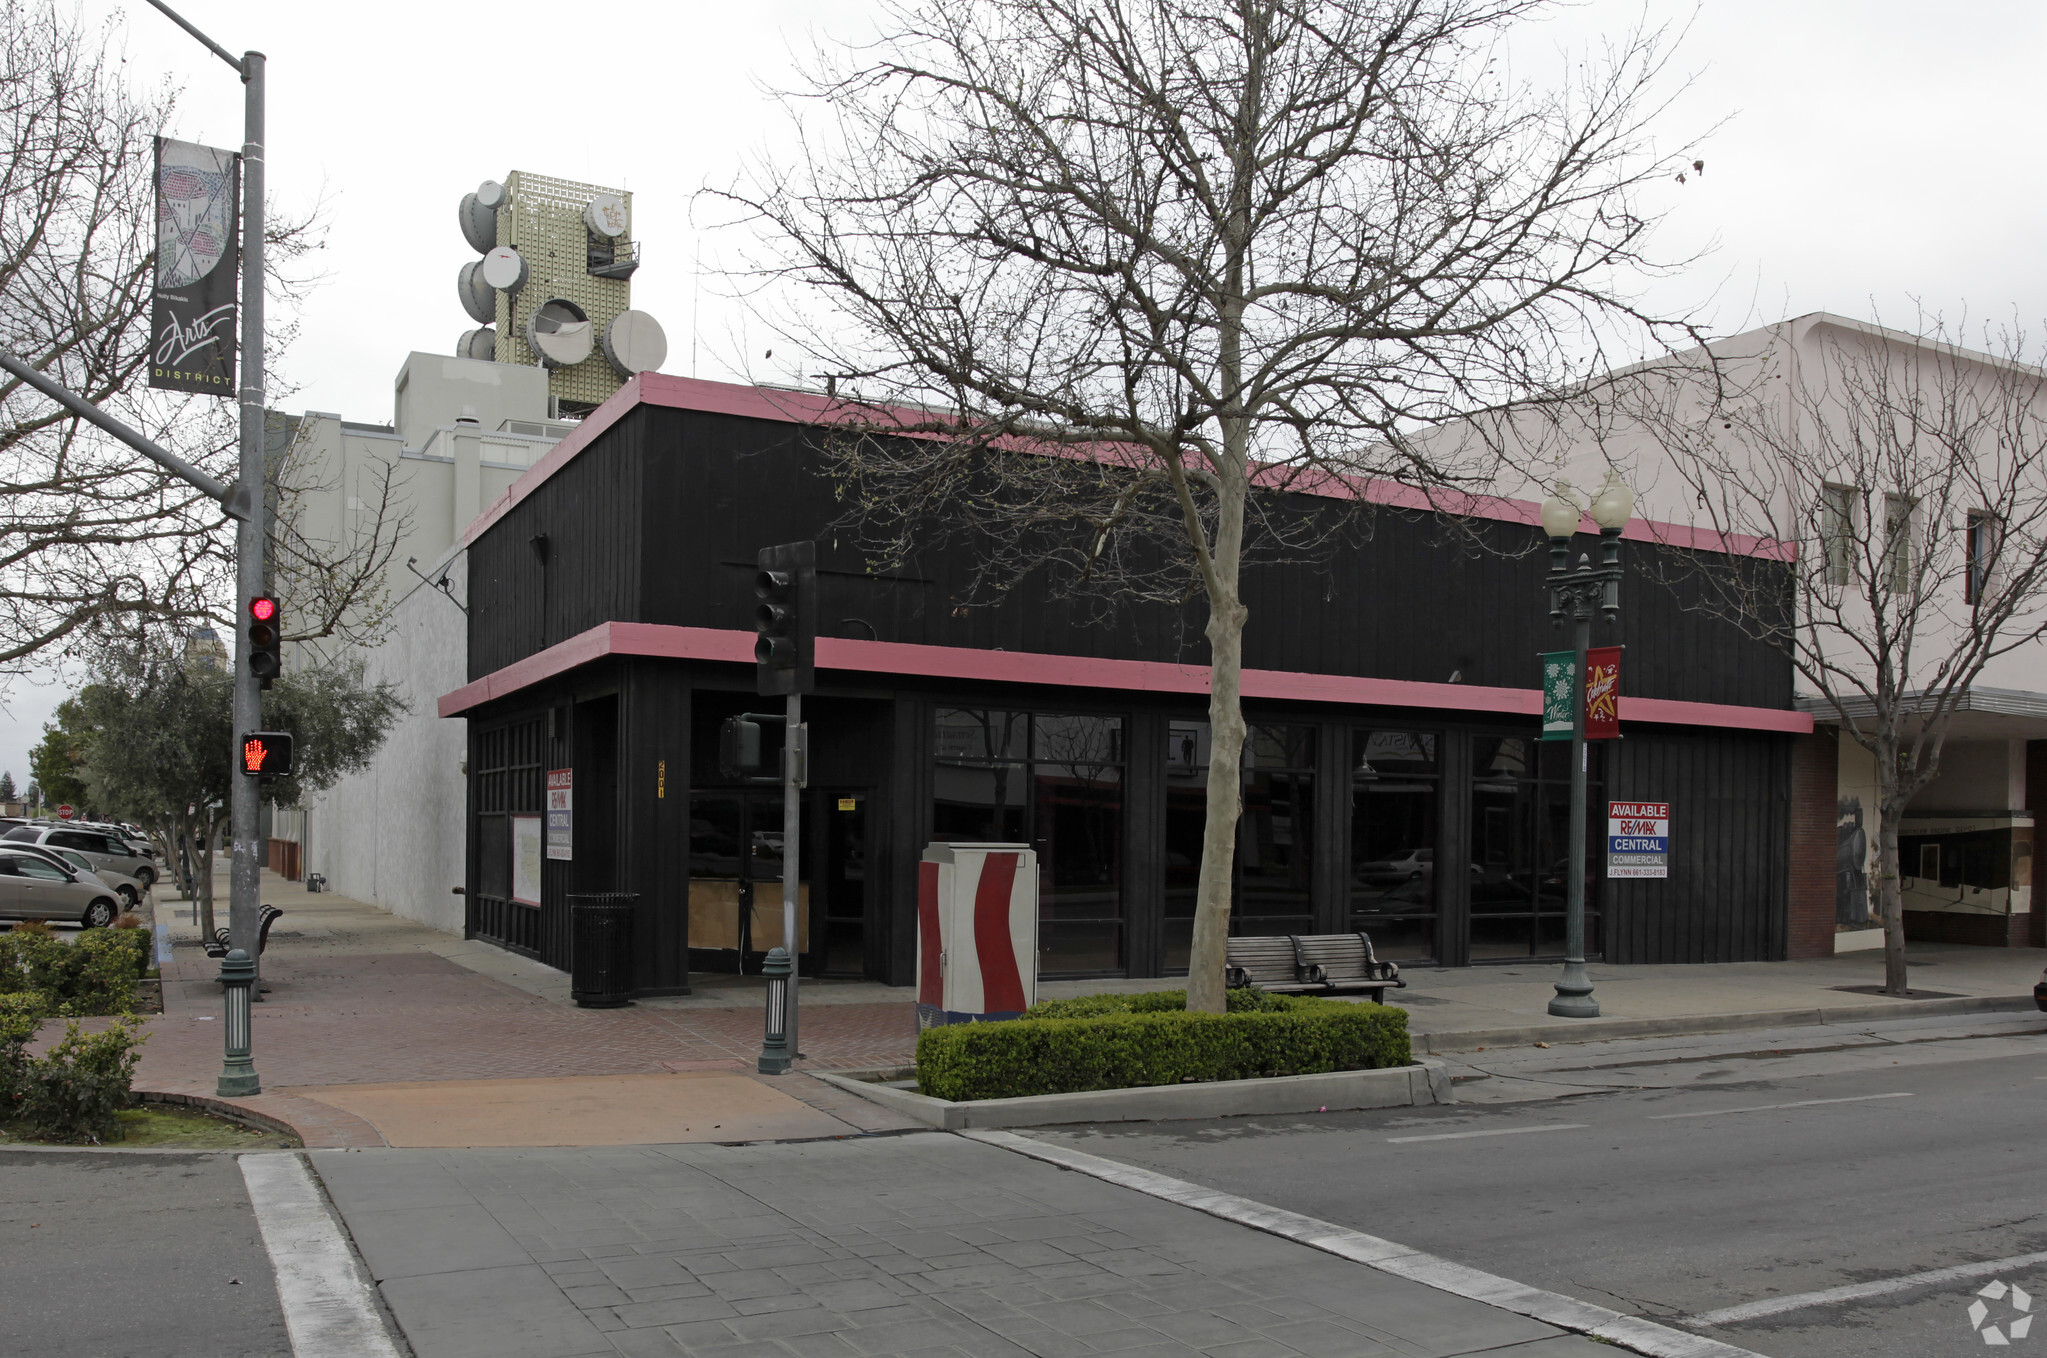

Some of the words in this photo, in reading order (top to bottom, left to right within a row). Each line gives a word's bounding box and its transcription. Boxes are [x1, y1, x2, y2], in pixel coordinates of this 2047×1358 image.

[156, 303, 235, 366] Arts
[155, 369, 230, 385] DISTRICT
[1586, 678, 1615, 703] Celebrate
[1547, 702, 1569, 720] Winter
[548, 772, 571, 787] AVAILABLE
[1611, 804, 1667, 817] AVAILABLE
[549, 813, 569, 827] CENTRAL
[1620, 820, 1657, 835] RE/MAX
[1614, 839, 1662, 851] CENTRAL
[1612, 855, 1664, 864] COMMERCIAL
